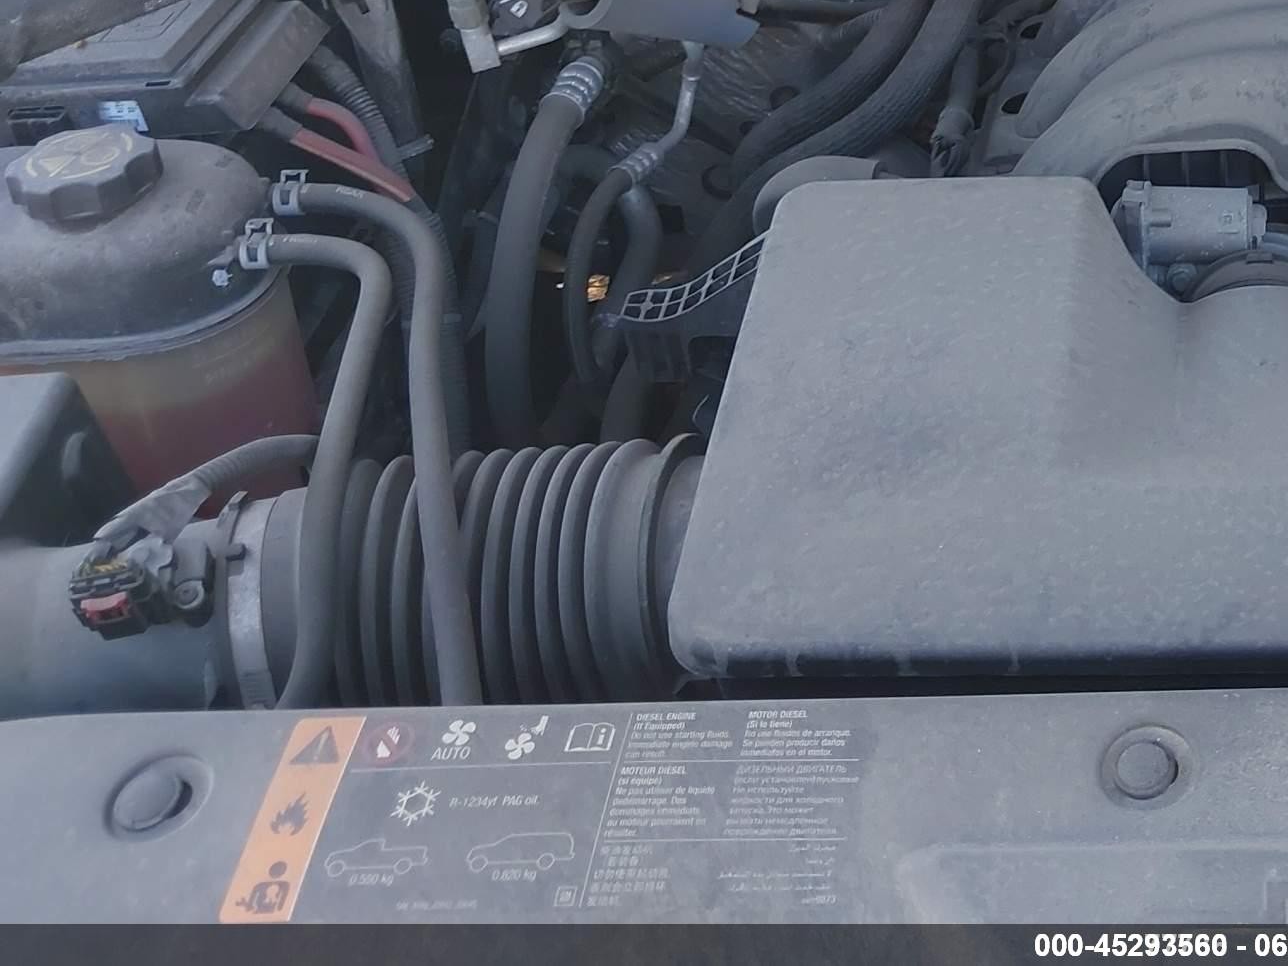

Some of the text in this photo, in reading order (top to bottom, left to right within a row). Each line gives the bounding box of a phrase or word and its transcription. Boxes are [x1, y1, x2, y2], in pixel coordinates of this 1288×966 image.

[637, 712, 697, 722] DIESEL ENGINE
[748, 709, 808, 719] MOTOR DIESEL
[644, 721, 686, 731] Equipped)
[746, 720, 758, 729] (Si
[769, 719, 793, 729] tiene)
[631, 731, 641, 739] Do
[673, 730, 705, 740] starting
[802, 729, 812, 737] de
[700, 739, 733, 750] damage
[742, 738, 753, 747] Se
[786, 738, 820, 748] producir
[431, 746, 471, 760] AUTO
[786, 748, 796, 756] en
[808, 748, 832, 756] motor.
[620, 765, 687, 775] MOTEUR DIESEL
[795, 765, 847, 775] ДВИГАТЕЛЬ
[674, 785, 685, 794] de
[449, 795, 498, 809] R-1234yf
[502, 794, 523, 807] PAG
[523, 868, 537, 883] kg
